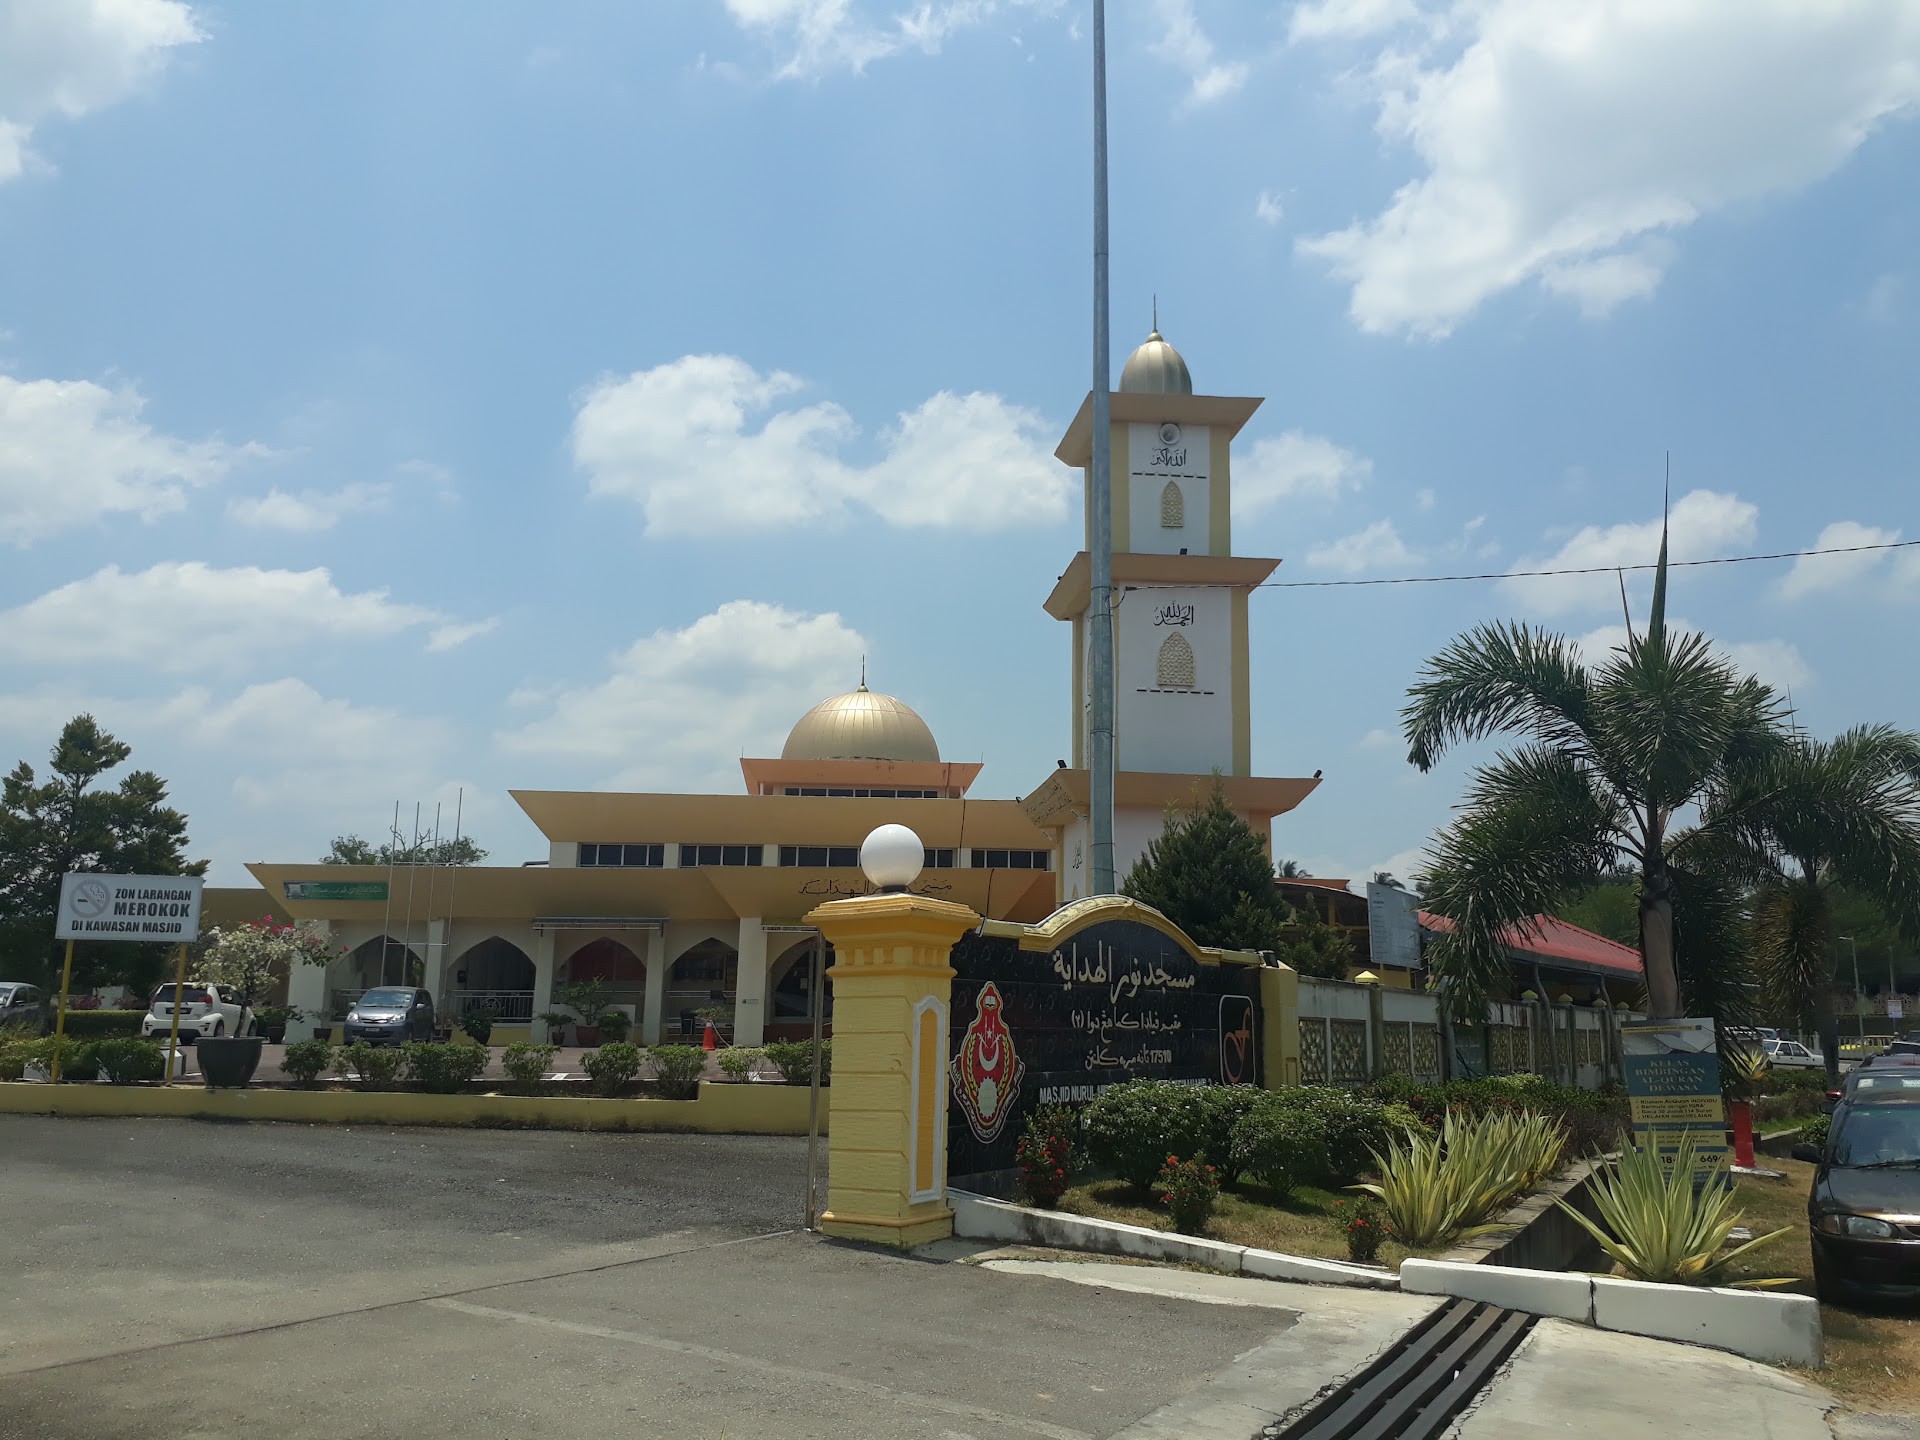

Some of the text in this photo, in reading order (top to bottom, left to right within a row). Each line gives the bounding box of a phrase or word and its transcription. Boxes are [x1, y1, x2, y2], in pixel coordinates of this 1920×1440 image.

[115, 888, 192, 901] ZON LARANGAN
[113, 902, 190, 917] MEROKOK
[71, 920, 182, 933] DI KAWASAN MASJID
[1053, 940, 1195, 1004] مسجد نور الهداية
[1150, 1049, 1172, 1063] 17510
[1635, 1067, 1705, 1076] BIMBINGAN
[1640, 1075, 1703, 1084] AL-QURAN
[1039, 1086, 1071, 1103] MASJID
[1071, 1084, 1095, 1102] NURUL
[1649, 1084, 1699, 1092] DEWASA
